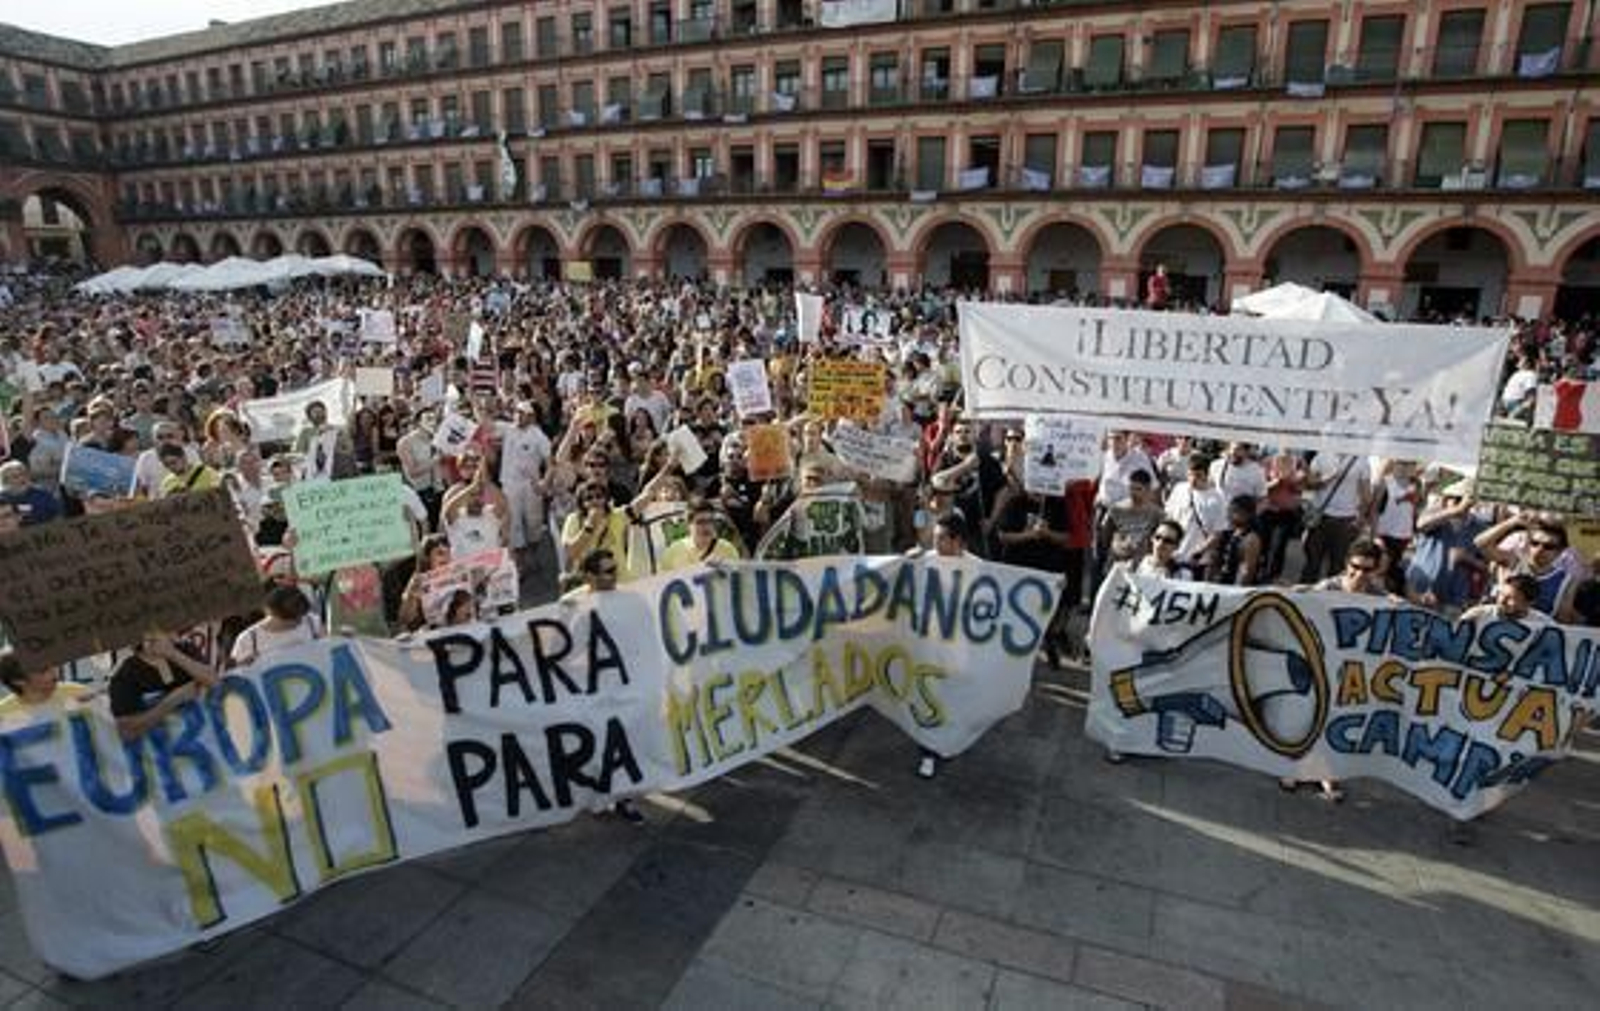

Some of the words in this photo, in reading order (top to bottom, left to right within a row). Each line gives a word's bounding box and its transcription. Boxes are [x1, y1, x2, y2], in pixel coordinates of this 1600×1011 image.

[973, 354, 1359, 423] CONSTITUYENTE
[1371, 386, 1458, 431] YA!
[1077, 317, 1334, 371] ¡LIBERTAD
[0, 644, 391, 837] EUROPA
[426, 609, 630, 713] PARA
[659, 563, 1054, 665] CIUDADAN@S
[166, 751, 400, 929] NO
[446, 717, 642, 828] PARA
